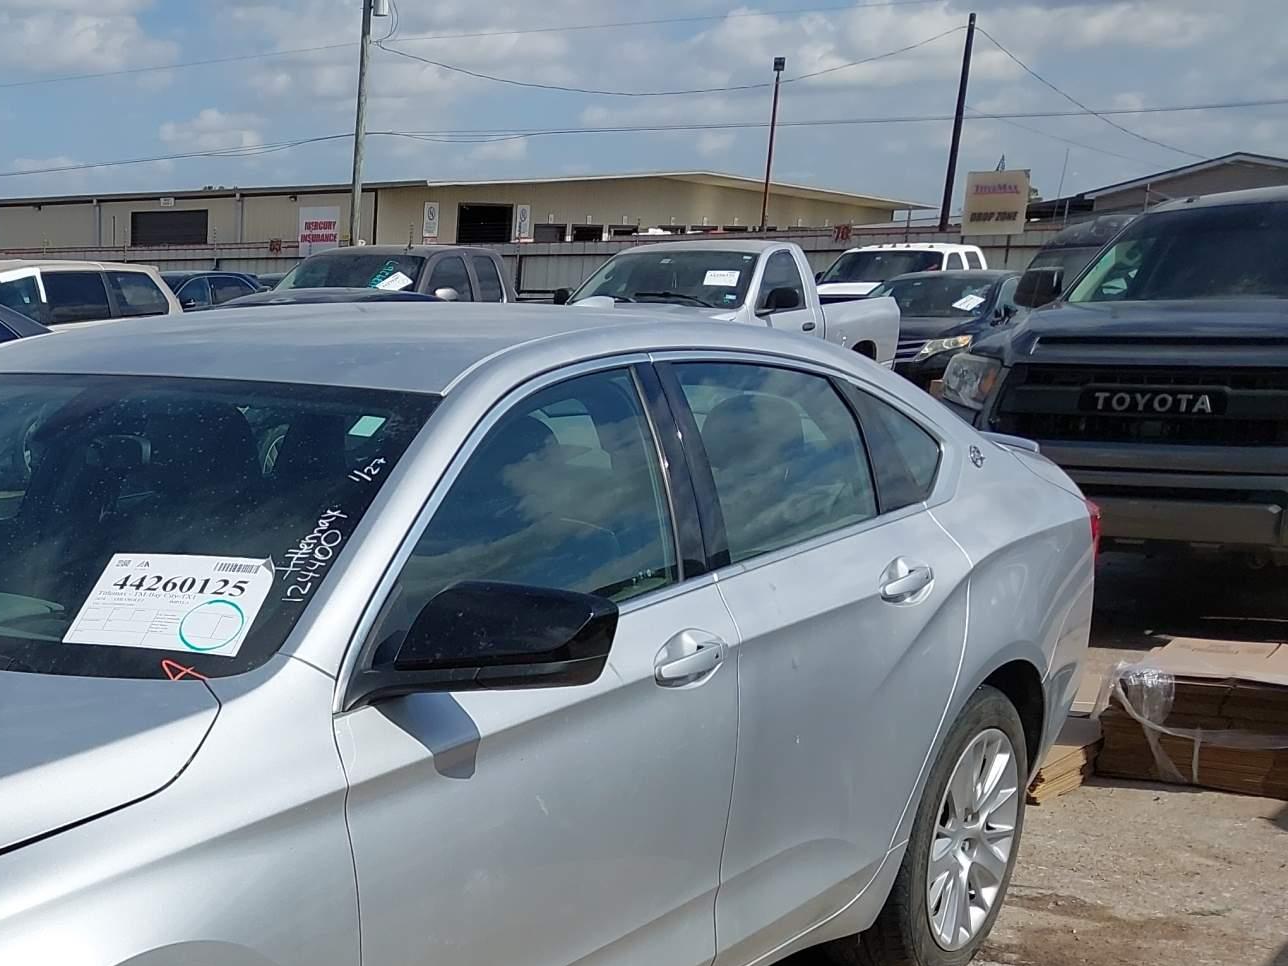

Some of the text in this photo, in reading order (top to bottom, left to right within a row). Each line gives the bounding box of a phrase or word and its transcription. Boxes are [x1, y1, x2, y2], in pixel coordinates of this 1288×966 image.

[304, 220, 337, 231] MERCURY
[300, 233, 338, 244] INSURANCE
[1094, 391, 1212, 413] TOYOTA
[281, 529, 342, 602] 124400
[113, 573, 250, 597] 44260125
